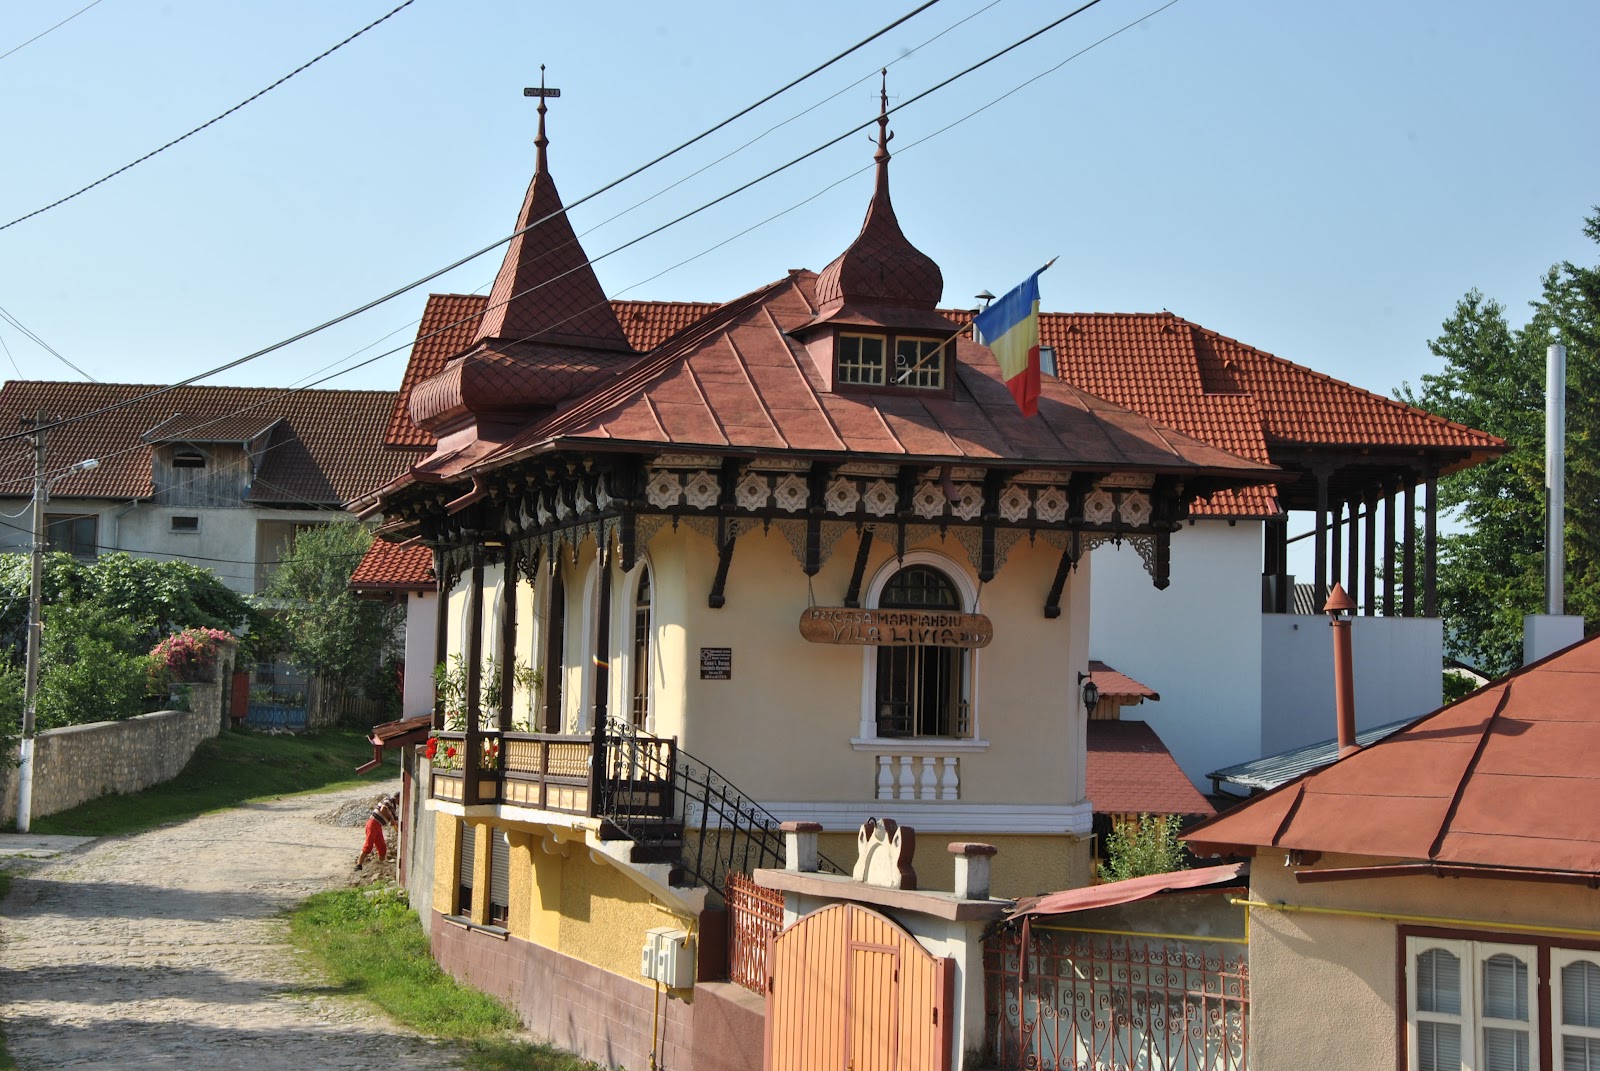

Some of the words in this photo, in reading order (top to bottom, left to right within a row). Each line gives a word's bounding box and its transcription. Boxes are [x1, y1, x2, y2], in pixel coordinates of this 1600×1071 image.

[810, 610, 833, 620] 1927
[834, 611, 872, 625] CASA
[877, 612, 962, 627] MARMANDIU
[828, 621, 881, 642] VILA
[890, 627, 959, 644] LIVIA
